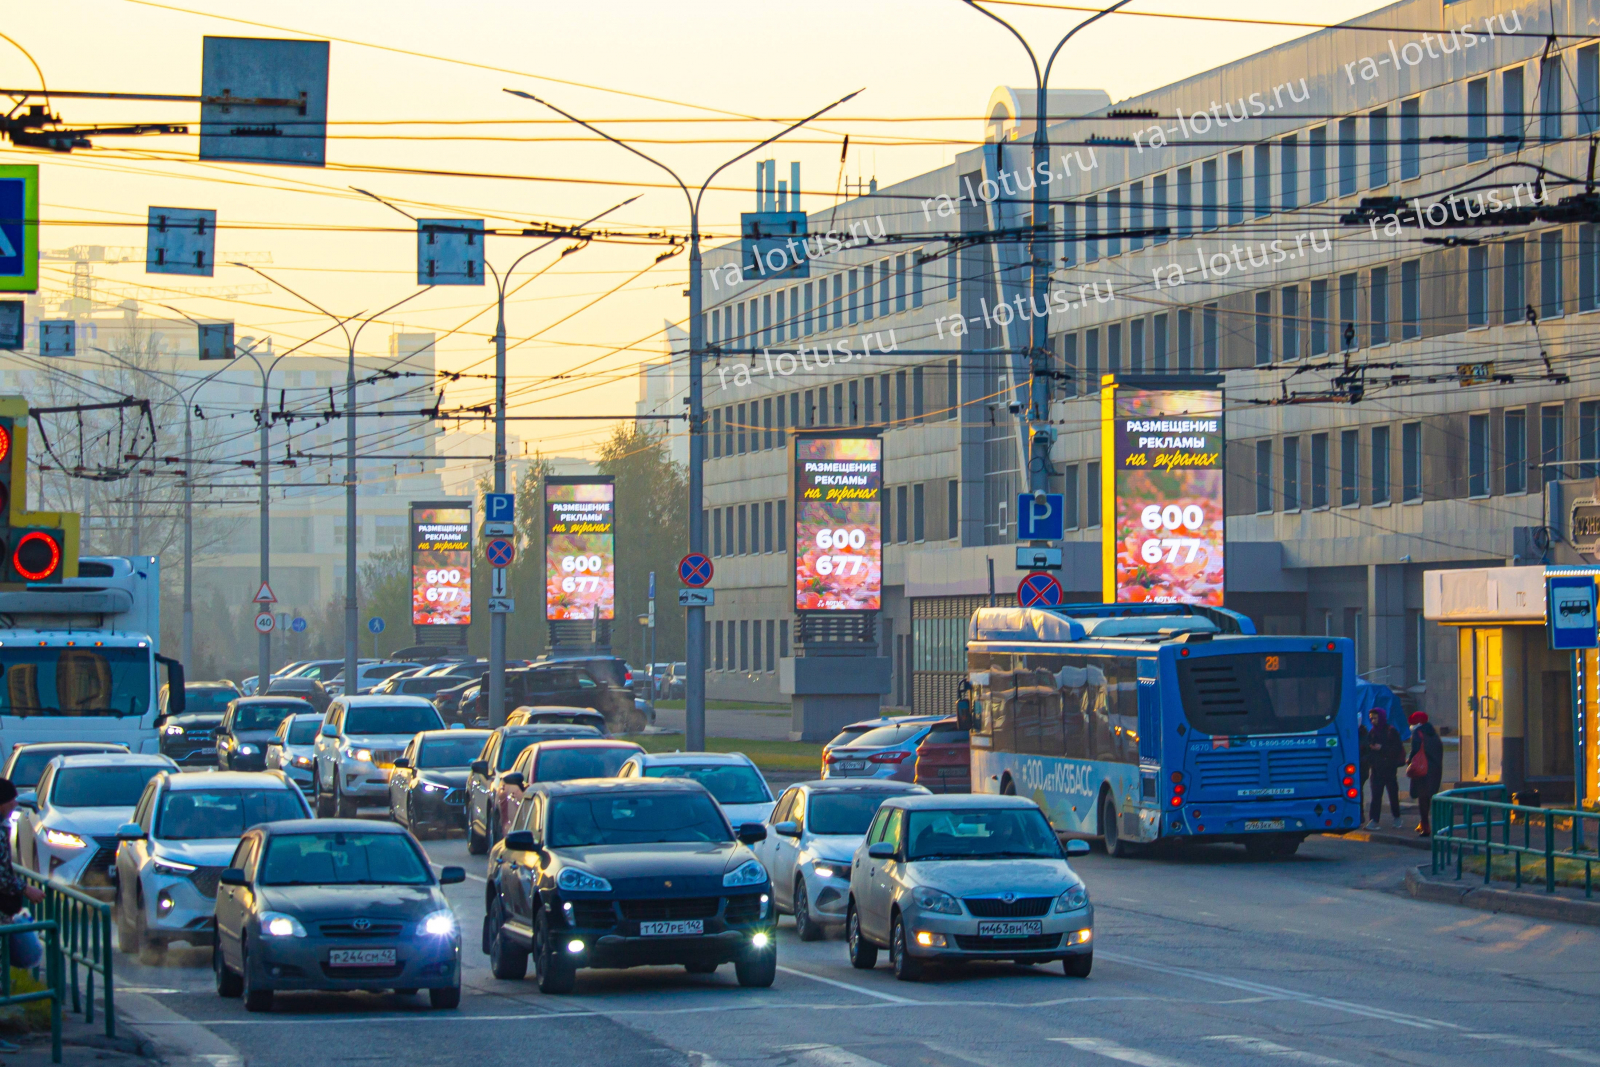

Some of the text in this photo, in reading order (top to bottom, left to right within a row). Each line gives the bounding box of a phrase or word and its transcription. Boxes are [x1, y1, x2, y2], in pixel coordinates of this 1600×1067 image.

[1127, 421, 1217, 433] РАЗМЕЩЕНИЕ
[1139, 437, 1204, 448] РЕКЛАМЫ
[805, 463, 876, 473] РАЗМЕЩЕНИЕ
[1126, 450, 1218, 472] на экранах
[815, 476, 867, 484] РЕКЛАМЫ
[804, 486, 878, 504] на экранах
[493, 497, 507, 518] P
[553, 504, 610, 512] РАЗМЕЩЕНИЕ
[1029, 500, 1052, 533] P
[1141, 505, 1204, 530] 600
[552, 524, 566, 532] на
[816, 529, 866, 549] 600
[1141, 539, 1202, 563] 677
[562, 555, 601, 572] 600
[816, 556, 863, 575] 677
[426, 570, 460, 584] 600
[562, 576, 600, 592] 677
[426, 588, 459, 601] 677
[259, 618, 272, 627] 40
[1265, 656, 1279, 670] 28
